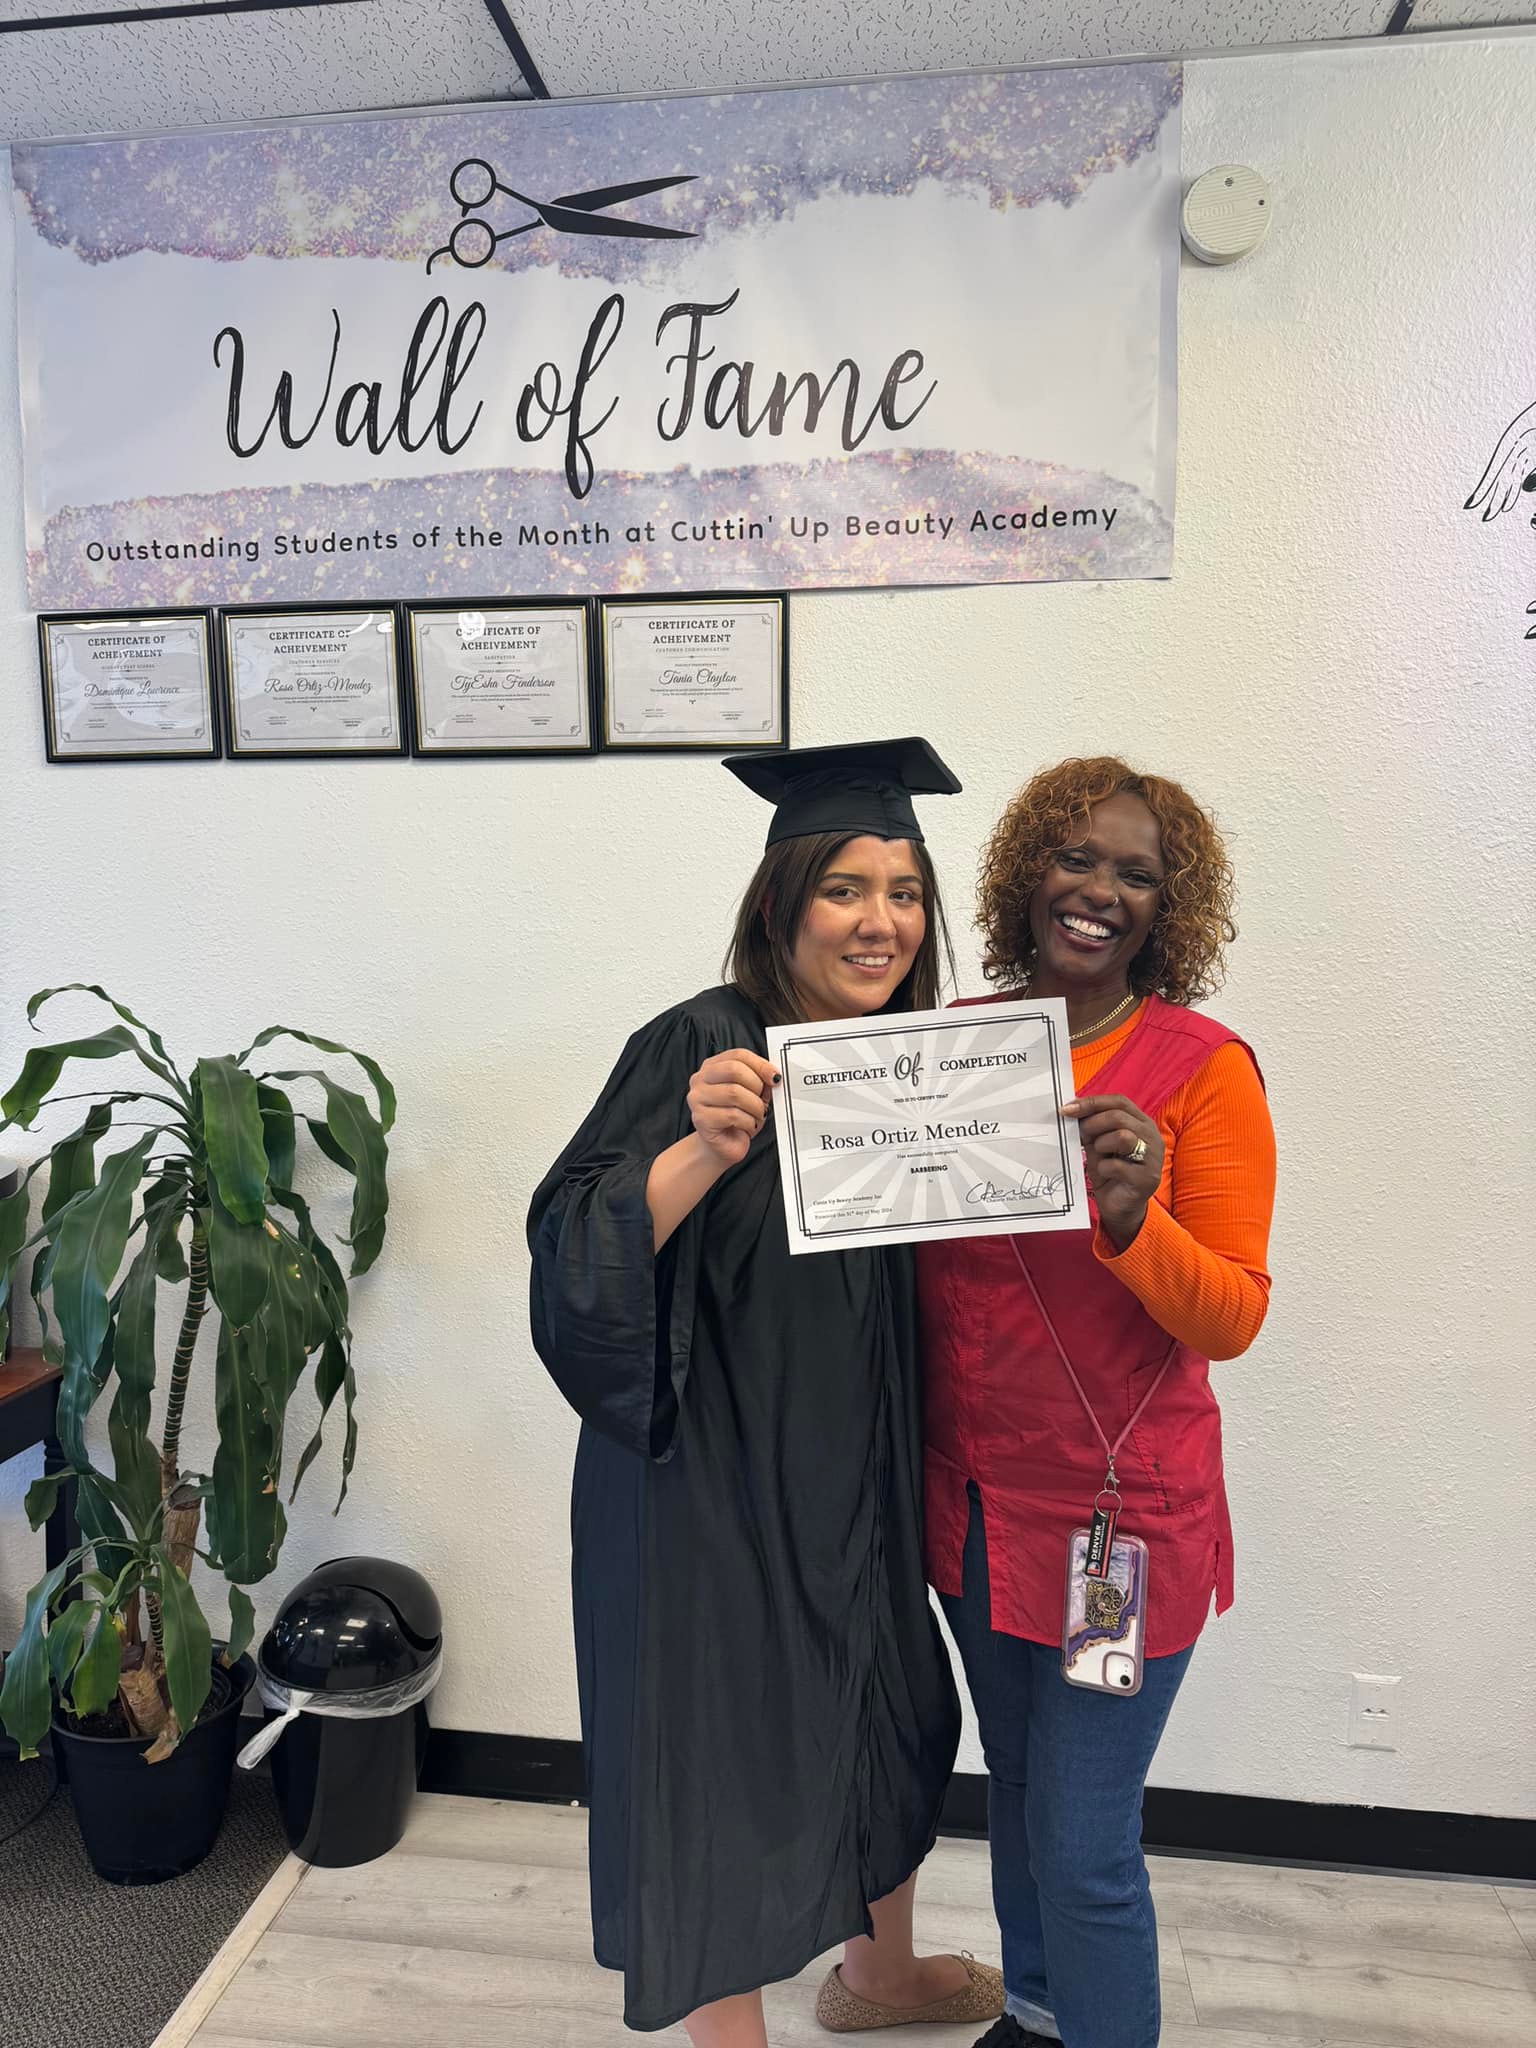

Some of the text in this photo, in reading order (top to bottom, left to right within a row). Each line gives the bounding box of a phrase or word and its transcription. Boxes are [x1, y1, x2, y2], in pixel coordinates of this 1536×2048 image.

[213, 288, 938, 499] Wall of Fame
[86, 504, 1118, 563] Outstanding Students of the Month at Cuttin' Up Beauty Academy
[269, 630, 335, 641] CERTIFICATE
[456, 626, 541, 637] CIFICATE OF
[648, 619, 736, 630] CERTIFICATE OF
[87, 635, 166, 647] CERTIFICATE OF
[264, 678, 293, 693] Rosa
[803, 1051, 1027, 1087] CERTIFICATE Of COMPLETION
[821, 1119, 1001, 1150] Rosa Ortiz Mendez
[1091, 1525, 1101, 1560] DENVER
